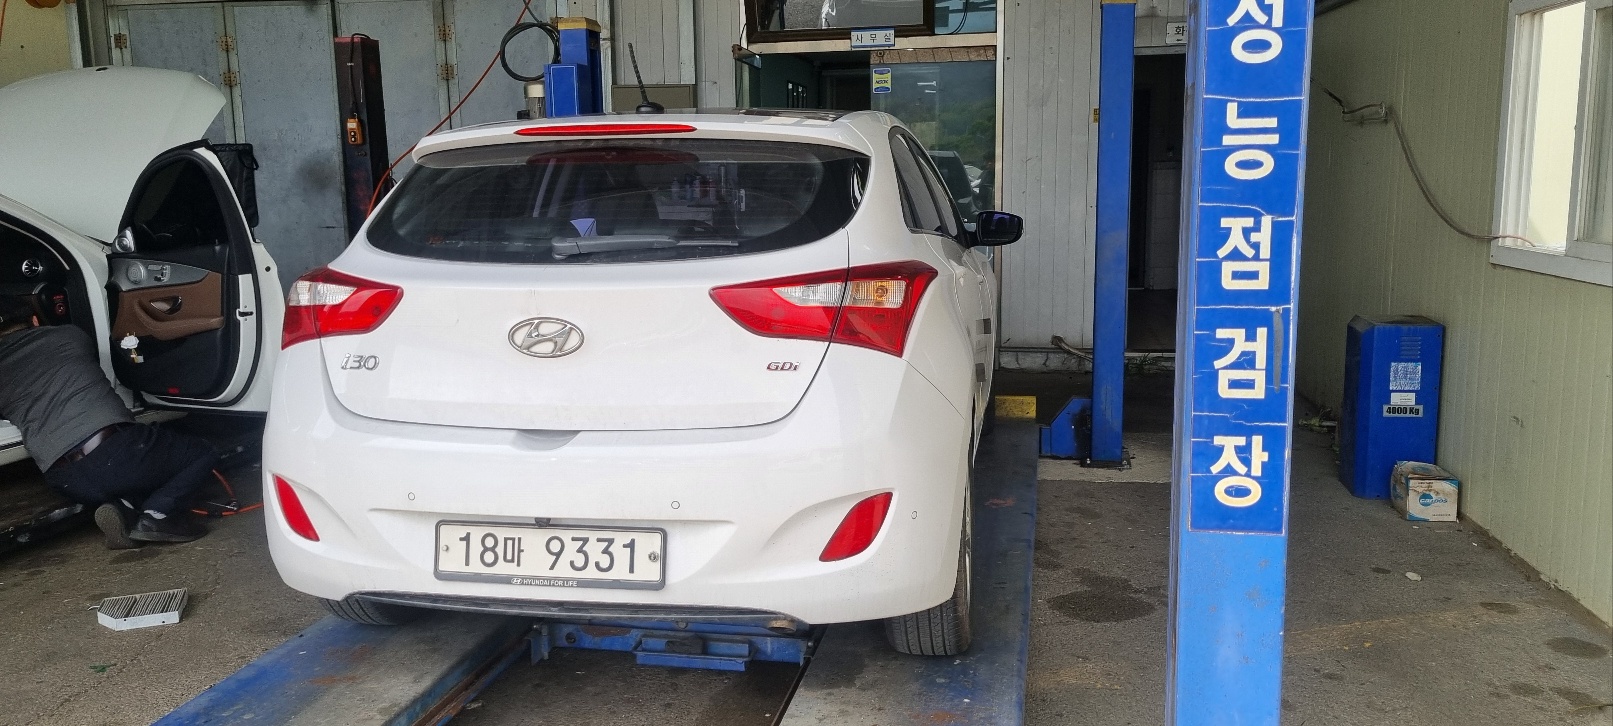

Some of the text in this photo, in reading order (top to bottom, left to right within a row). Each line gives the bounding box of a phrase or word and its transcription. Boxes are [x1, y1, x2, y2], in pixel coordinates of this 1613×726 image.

[856, 33, 892, 43] 사무실
[341, 353, 380, 370] i30
[767, 361, 800, 371] GDi
[1386, 406, 1419, 415] 4000 Kg
[458, 531, 636, 574] 18마 9331
[523, 578, 550, 586] HYUNDAI
[550, 579, 564, 587] FOR
